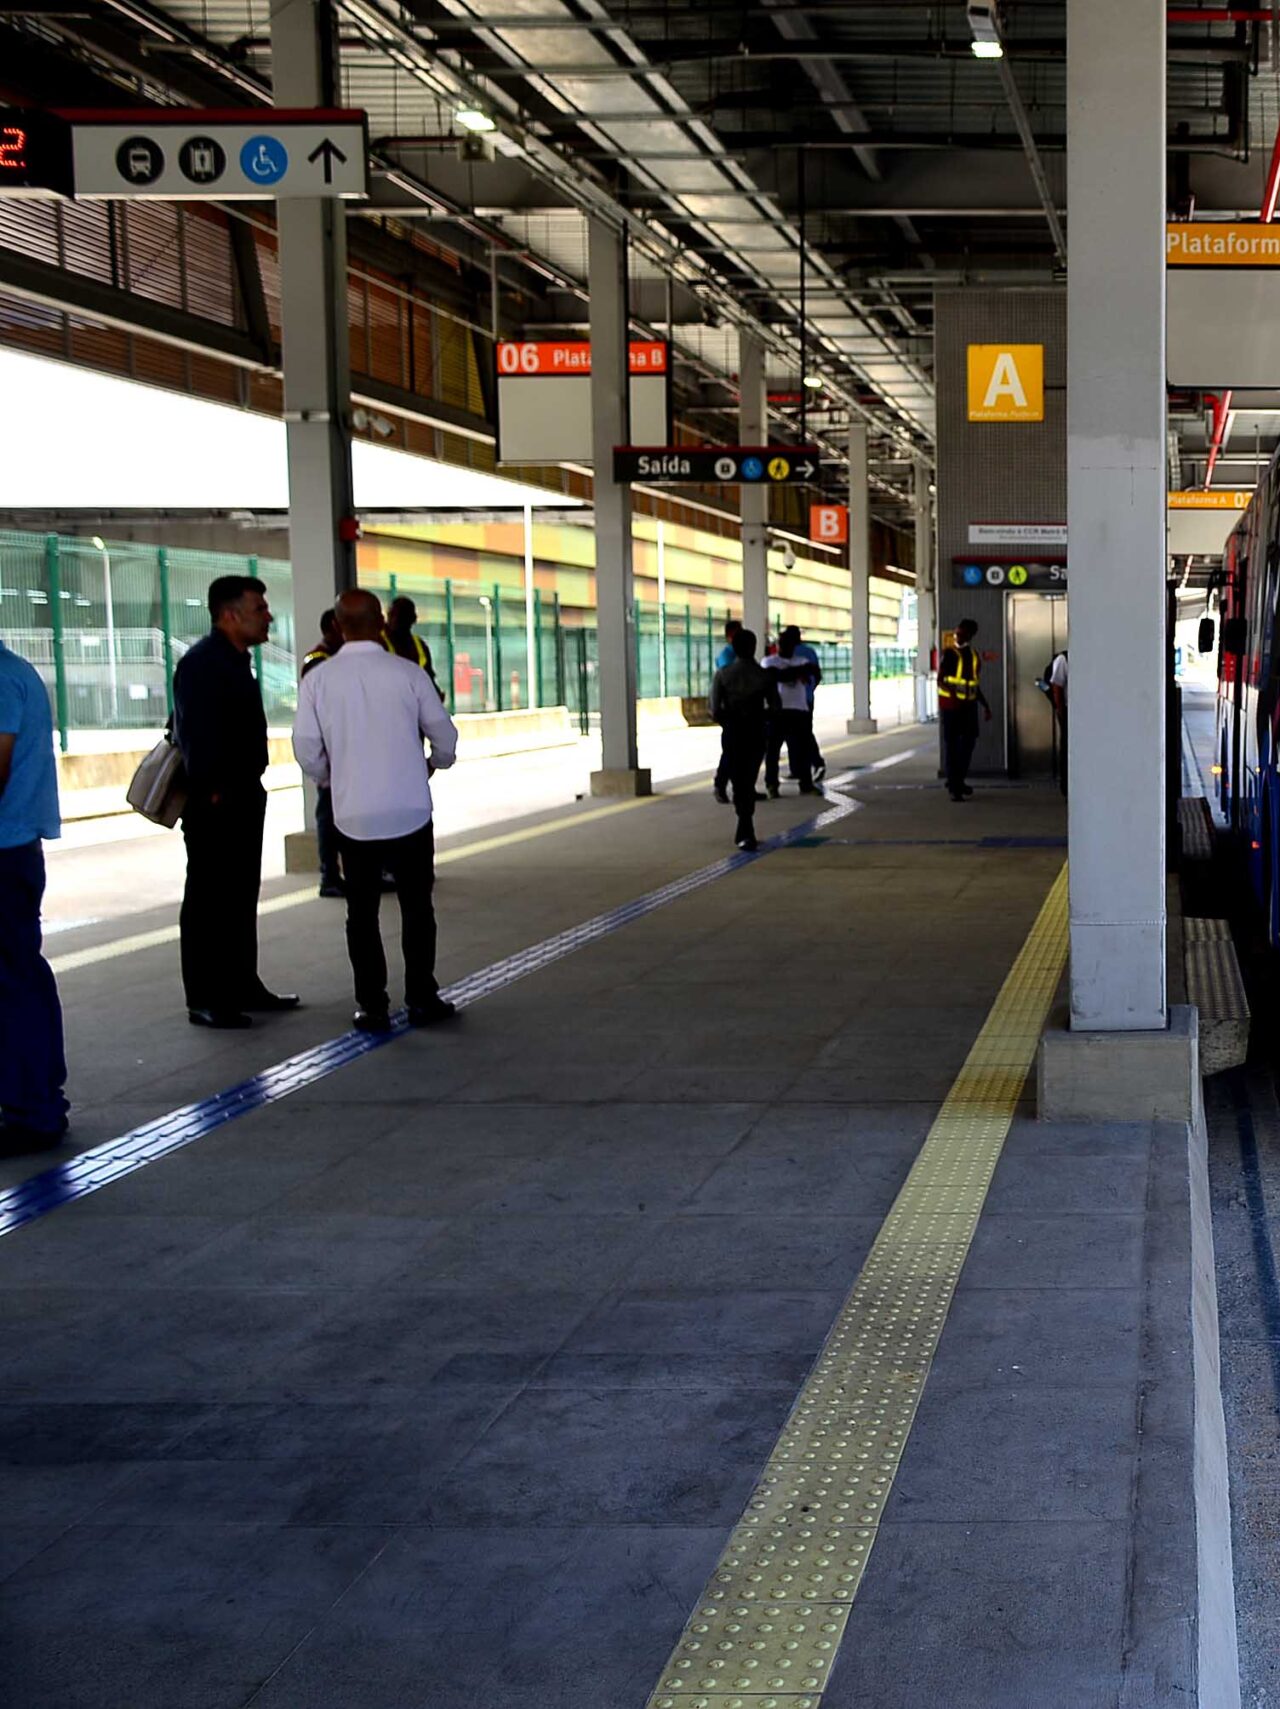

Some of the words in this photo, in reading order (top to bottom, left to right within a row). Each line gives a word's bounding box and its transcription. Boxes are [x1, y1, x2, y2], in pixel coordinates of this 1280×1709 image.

[501, 343, 540, 373] 06
[553, 348, 647, 368] Plataa
[651, 348, 663, 367] B
[983, 352, 1028, 407] A
[638, 454, 691, 475] Saída
[1168, 494, 1217, 505] Plataforma
[819, 509, 841, 537] B
